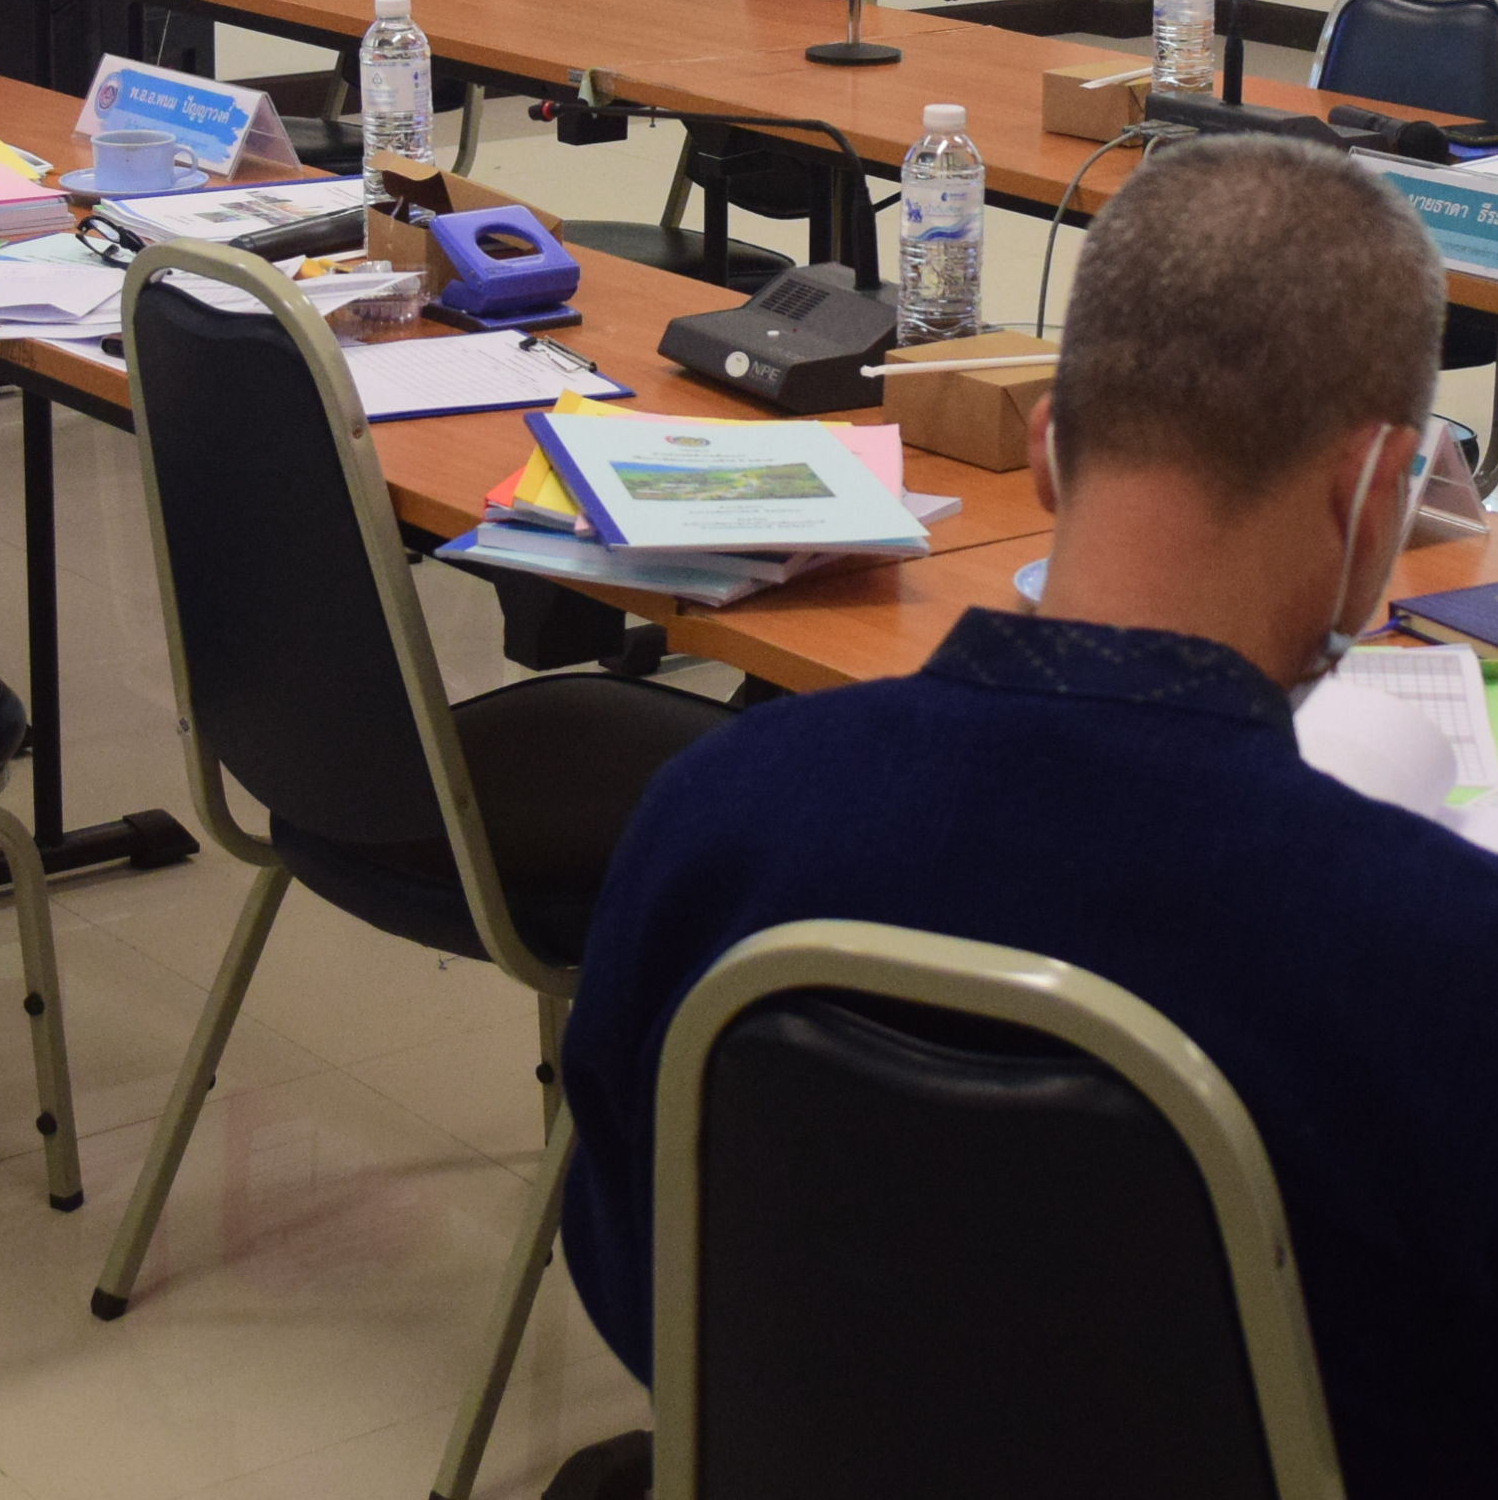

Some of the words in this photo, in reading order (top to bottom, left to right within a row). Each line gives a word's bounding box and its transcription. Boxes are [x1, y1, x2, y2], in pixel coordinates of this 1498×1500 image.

[130, 86, 178, 111] พ.อ.อ.พนม
[182, 95, 236, 124] ปัญญาวงค์
